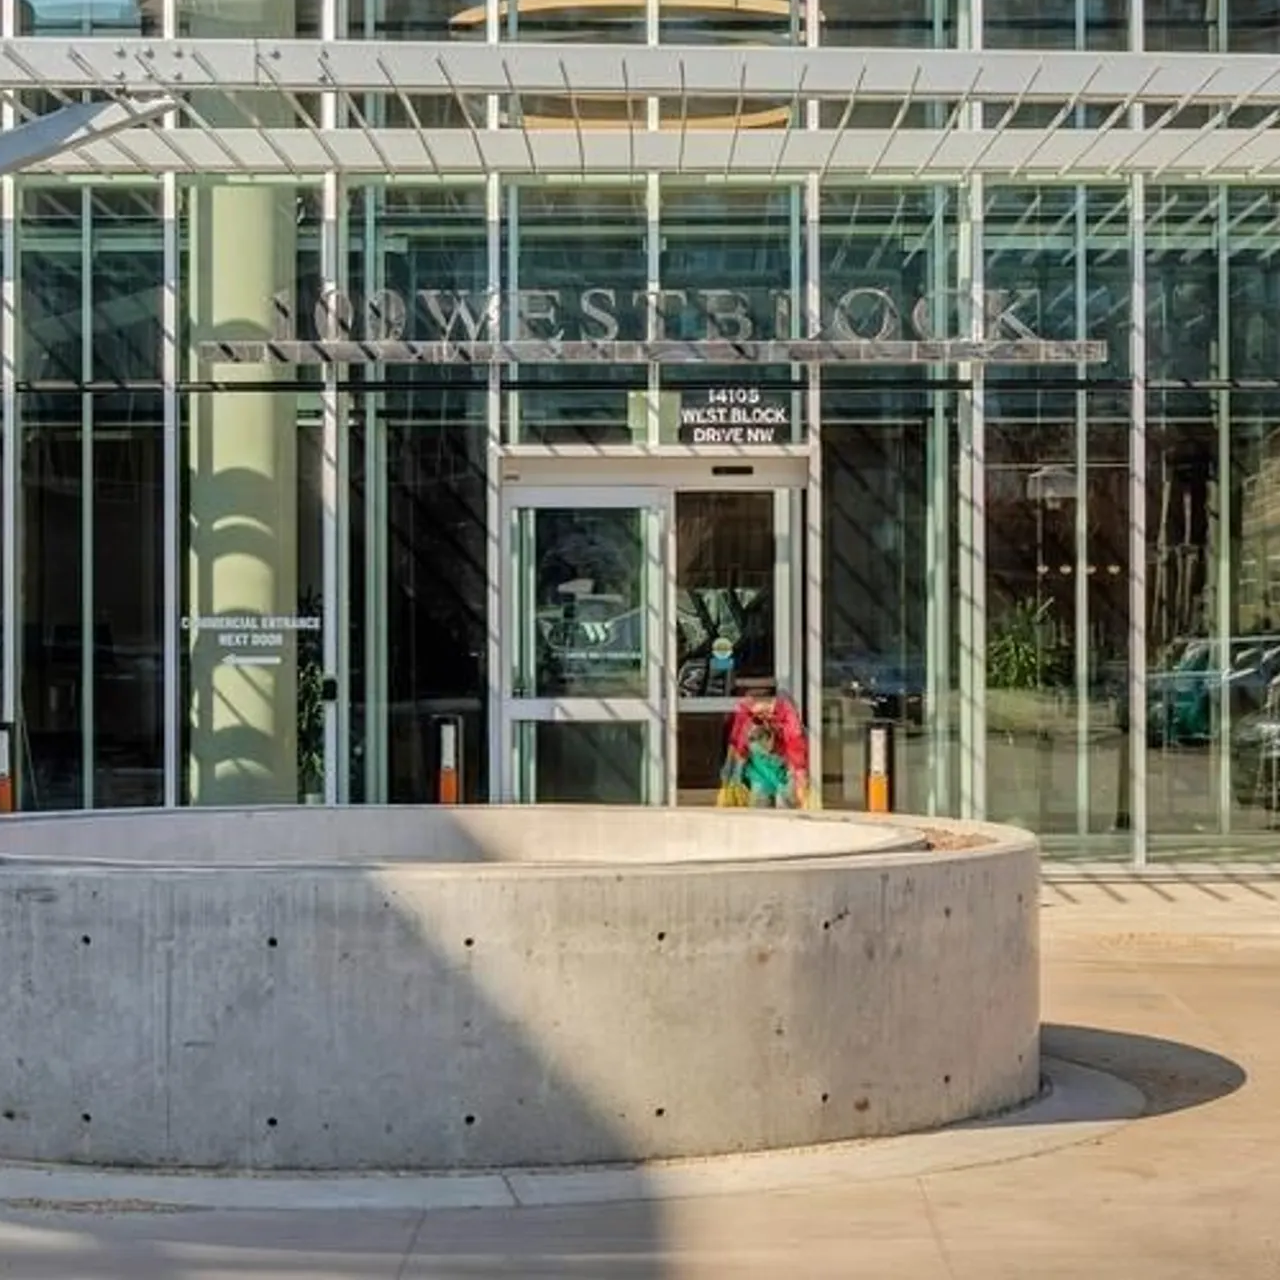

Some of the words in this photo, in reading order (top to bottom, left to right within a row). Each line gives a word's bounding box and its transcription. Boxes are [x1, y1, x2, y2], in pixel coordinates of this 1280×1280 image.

[416, 288, 687, 342] WEST
[698, 287, 1040, 342] BLOCK
[708, 388, 760, 403] 14105
[681, 407, 727, 423] WEST
[730, 407, 789, 423] BLOCK
[693, 427, 743, 442] DRIVE
[747, 427, 775, 442] NW
